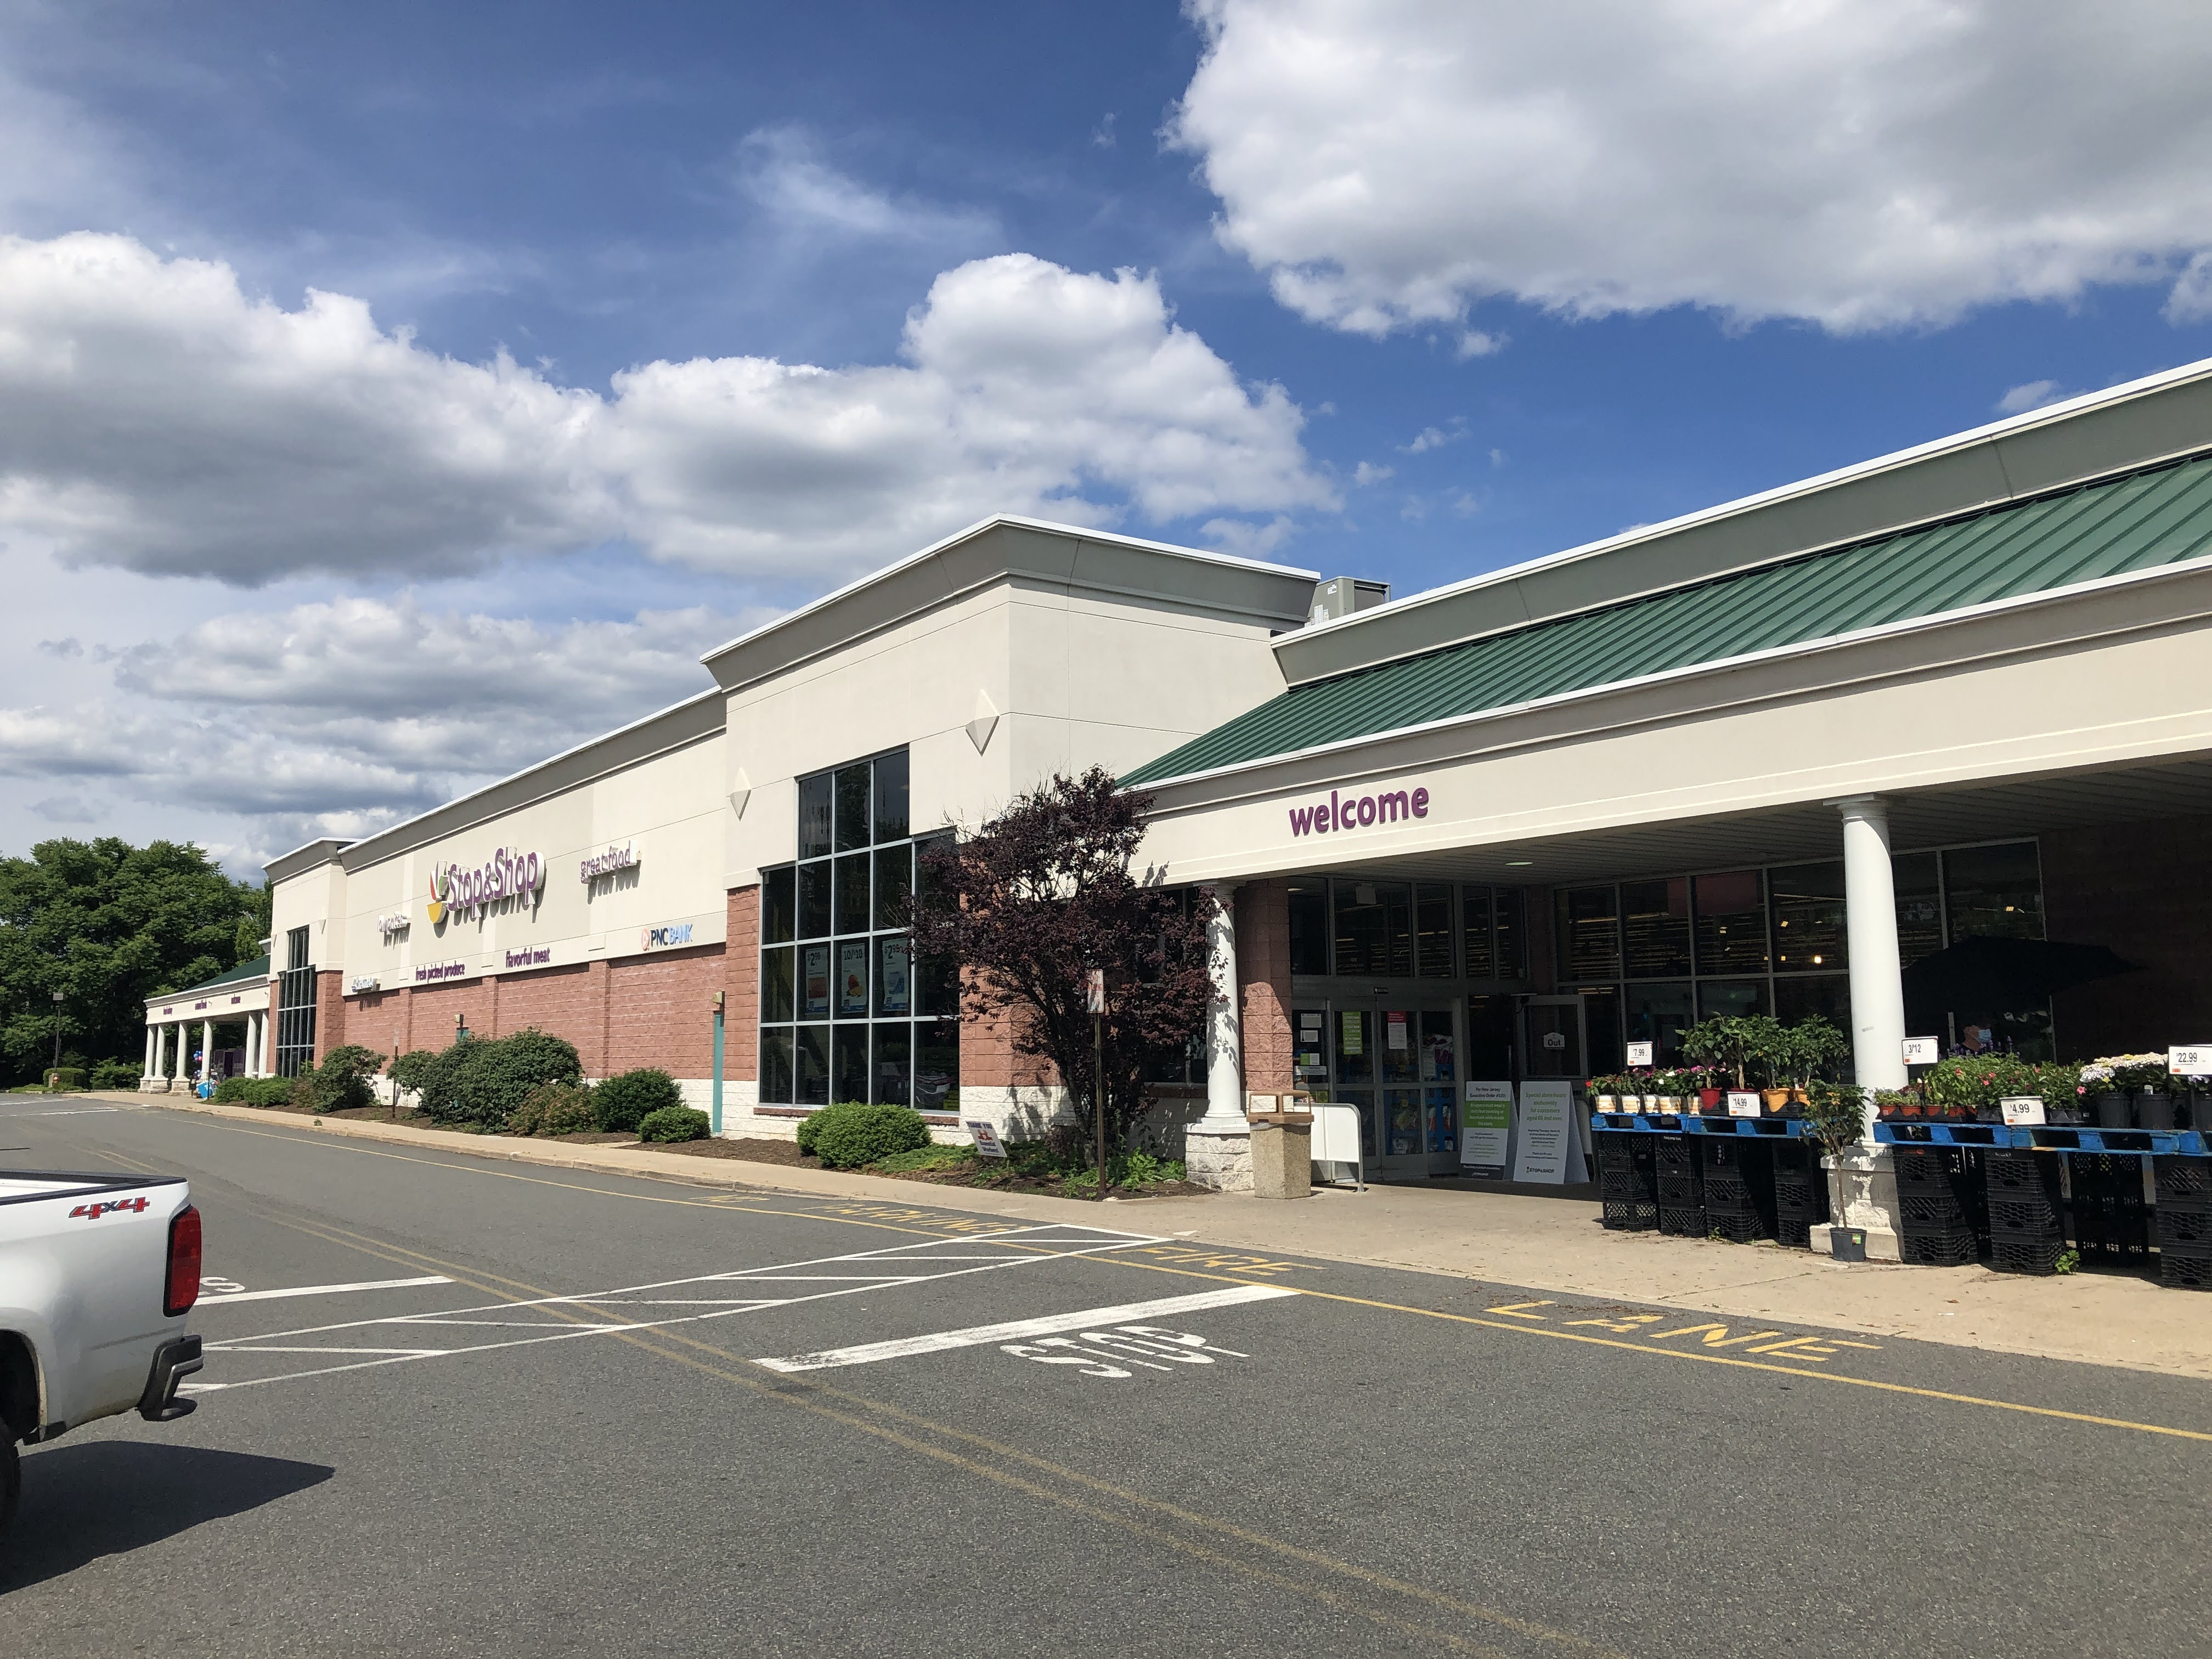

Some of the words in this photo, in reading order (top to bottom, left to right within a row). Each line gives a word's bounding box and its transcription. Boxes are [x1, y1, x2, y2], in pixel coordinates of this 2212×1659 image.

[1289, 787, 1429, 838] welcome
[580, 853, 607, 884] great
[607, 840, 632, 870] food
[650, 927, 669, 947] PNC
[668, 924, 693, 945] BANK
[506, 946, 532, 968] flavorful
[533, 946, 550, 964] meat
[415, 966, 427, 981] fresh
[427, 962, 443, 984] picked
[444, 960, 465, 981] produce
[2176, 1052, 2198, 1063] $22.99
[2010, 1103, 2030, 1113] $4.99
[1110, 1246, 1328, 1276] FIRE
[1481, 1300, 1884, 1362] LANE
[999, 1325, 1251, 1378] STOP
